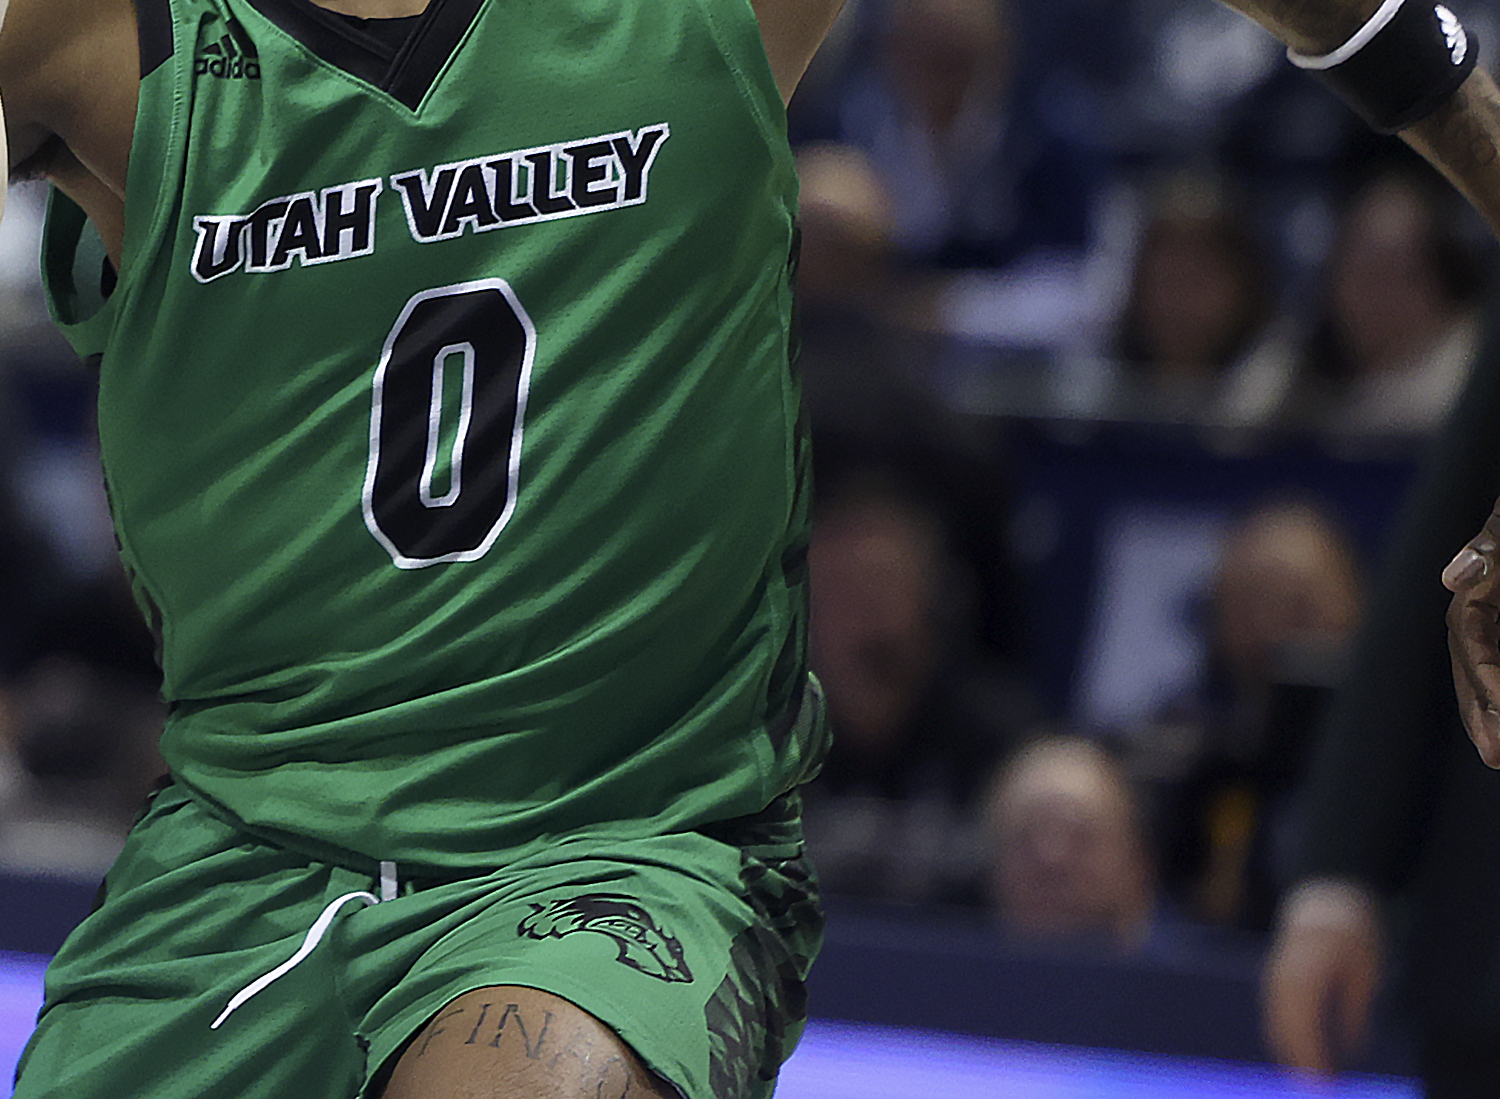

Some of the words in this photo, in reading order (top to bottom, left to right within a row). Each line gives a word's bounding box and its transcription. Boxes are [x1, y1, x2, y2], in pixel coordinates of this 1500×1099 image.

[194, 57, 261, 79] adida
[190, 179, 383, 284] UTAH
[390, 122, 669, 244] VALLEY
[362, 277, 537, 569] 0
